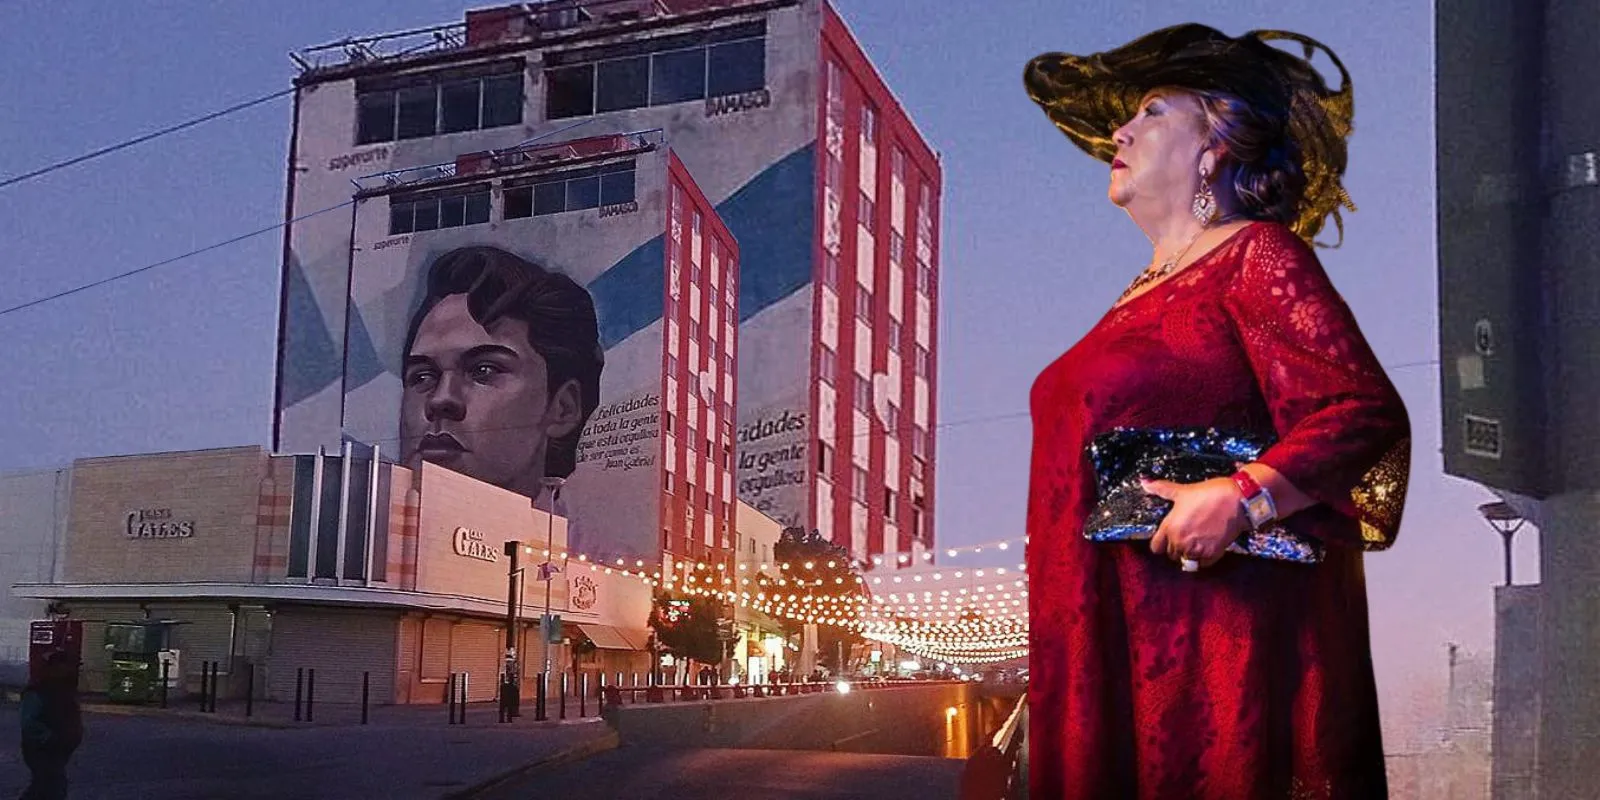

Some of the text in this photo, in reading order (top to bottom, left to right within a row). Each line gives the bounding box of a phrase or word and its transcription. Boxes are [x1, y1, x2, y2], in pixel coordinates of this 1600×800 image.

[593, 421, 617, 434] toda
[619, 418, 629, 430] la
[631, 413, 659, 431] gente
[738, 444, 806, 473] la gente
